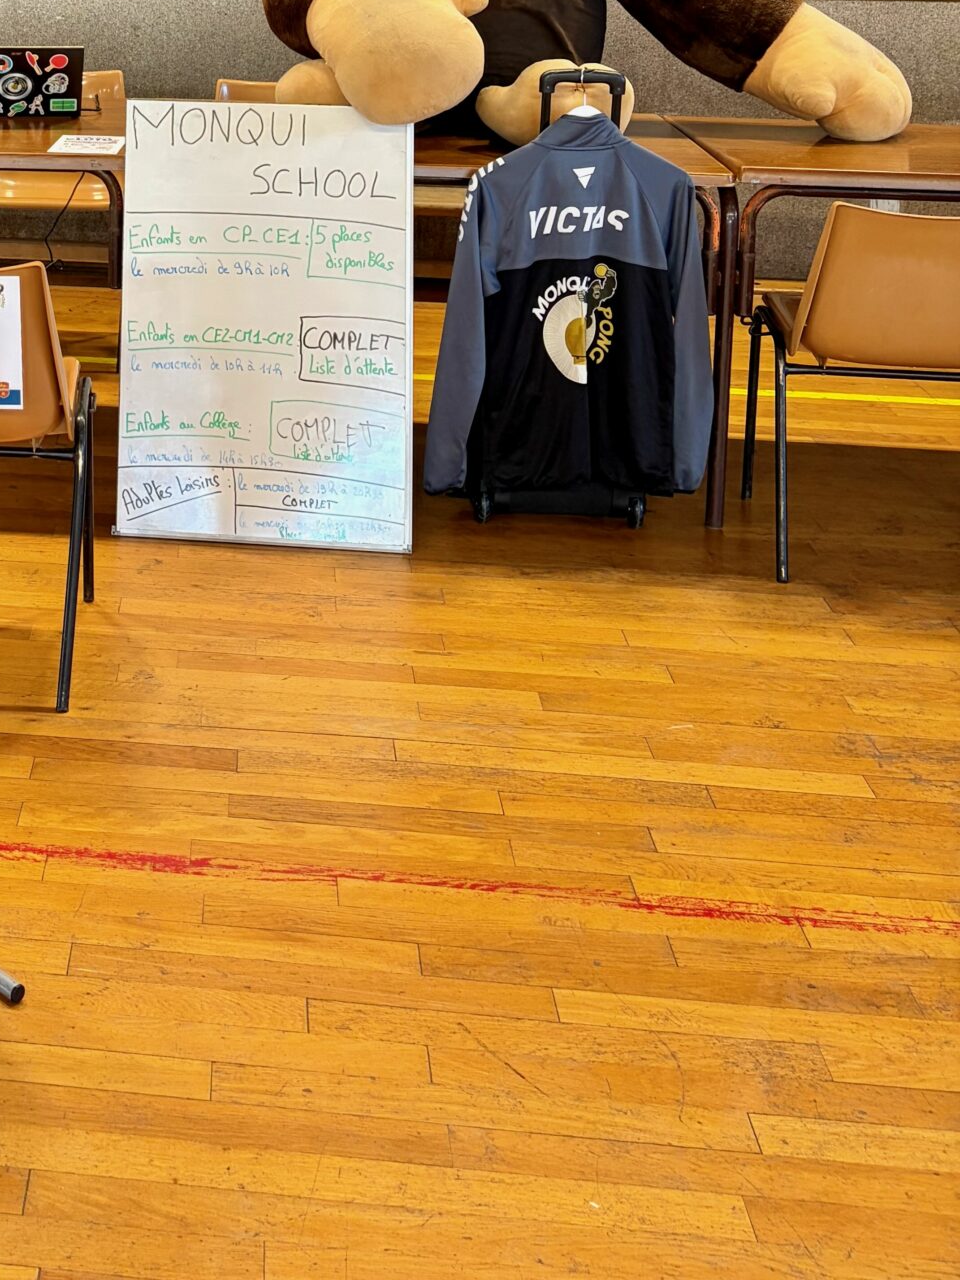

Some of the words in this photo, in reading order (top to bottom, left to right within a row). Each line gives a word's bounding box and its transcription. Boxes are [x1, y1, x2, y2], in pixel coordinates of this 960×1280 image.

[132, 103, 307, 150] MONQUI
[250, 163, 397, 200] SCHOOL
[528, 205, 630, 240] VICTAS
[129, 224, 182, 249] Enfants
[189, 234, 208, 246] en
[314, 225, 326, 245] 5
[130, 257, 144, 277] le
[152, 257, 208, 275] mercredi
[217, 258, 230, 275] de
[255, 262, 265, 275] à
[127, 320, 175, 345] Enfants
[183, 332, 199, 343] en
[303, 326, 405, 351] COMPLET
[588, 306, 615, 365] PONG
[130, 354, 142, 372] le
[151, 355, 202, 371] mercredi
[210, 356, 220, 370] de
[247, 359, 256, 371] à
[309, 354, 336, 375] Liste
[344, 354, 399, 376] d'attente
[125, 410, 170, 433] Enfants
[179, 421, 196, 430] au
[276, 416, 386, 448] COMPLET
[176, 474, 221, 496] Loisirs
[238, 472, 248, 491] le
[281, 494, 339, 510] COMPLET
